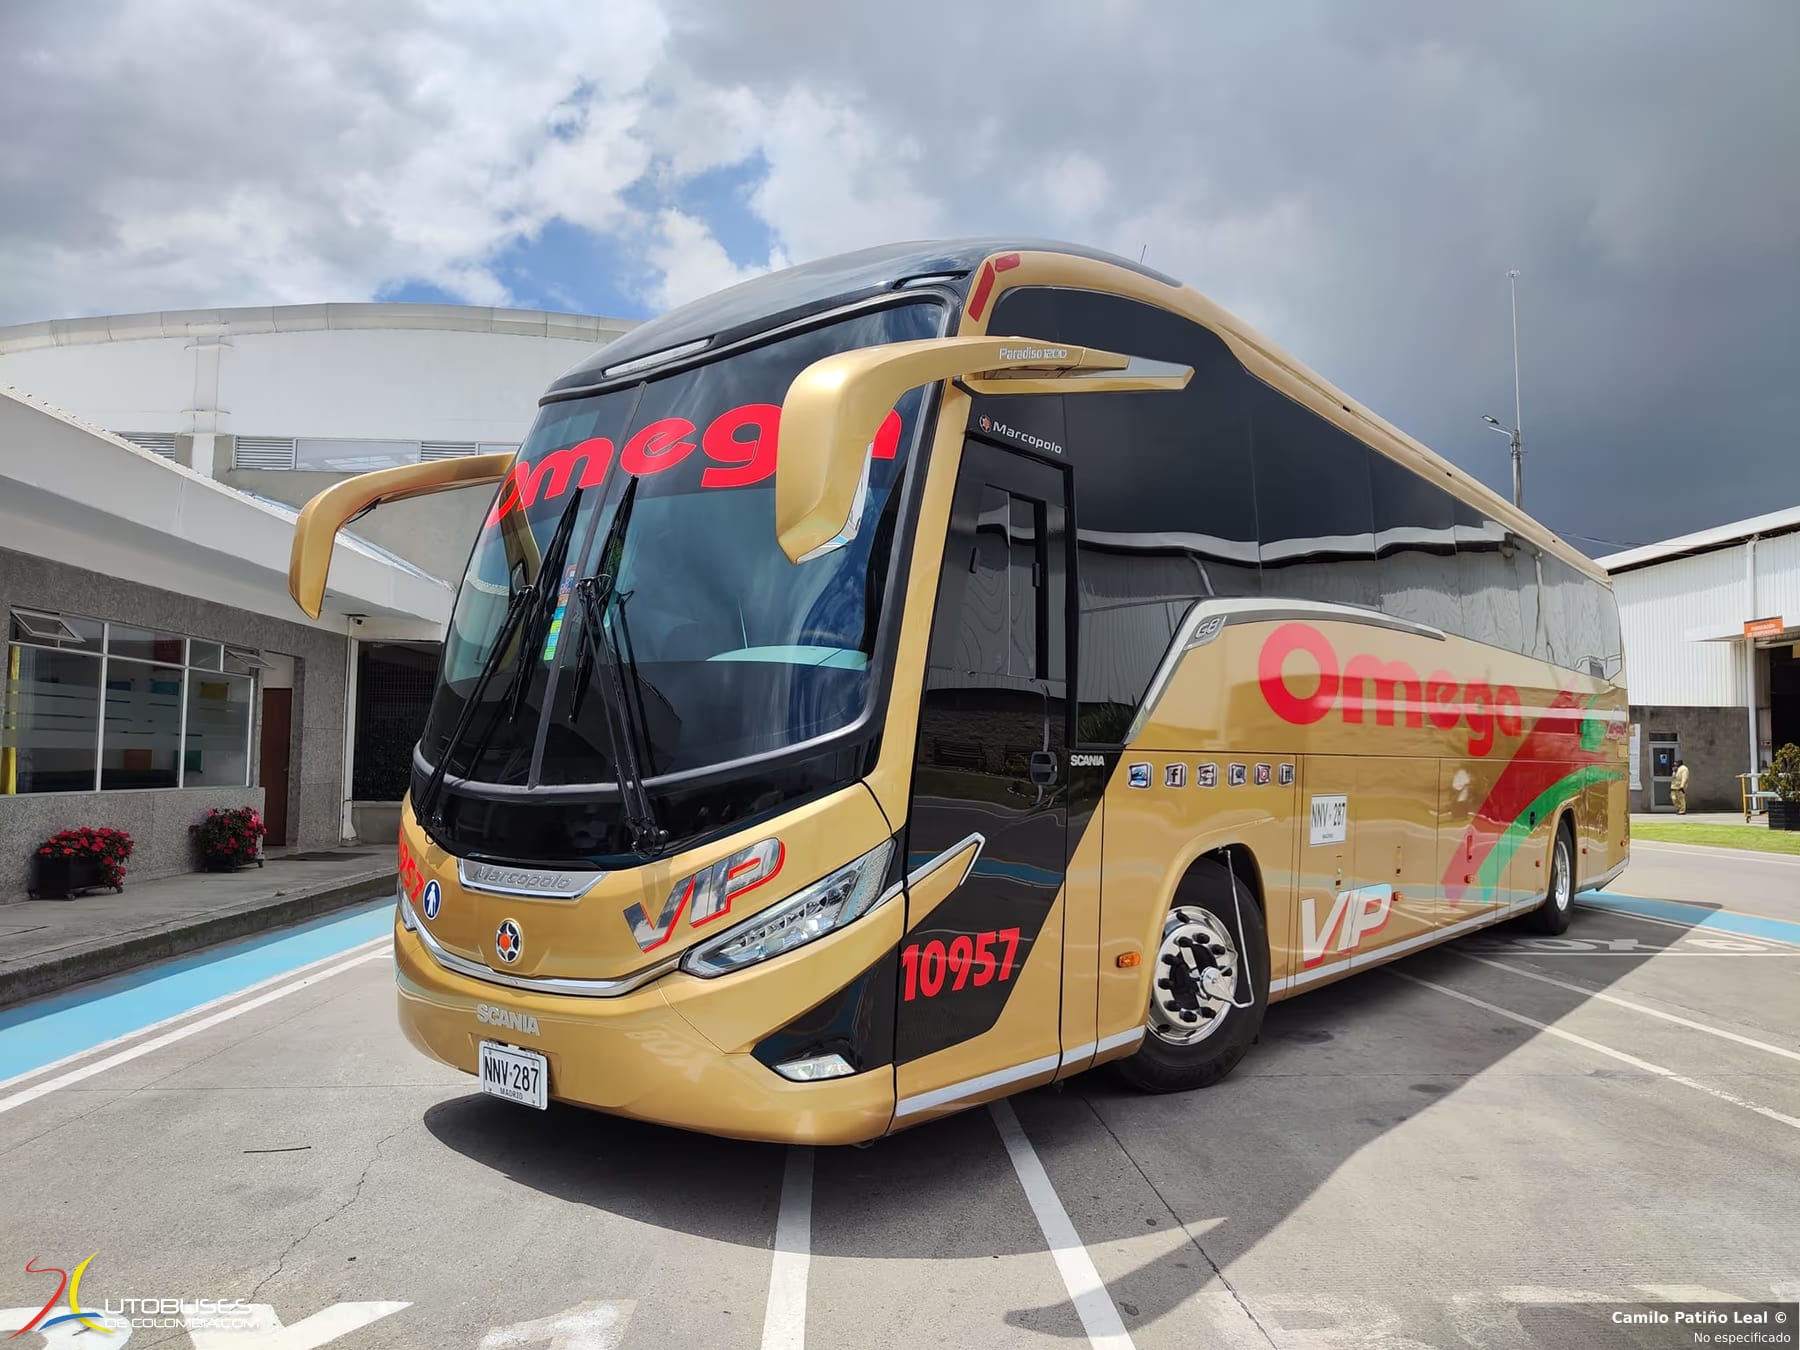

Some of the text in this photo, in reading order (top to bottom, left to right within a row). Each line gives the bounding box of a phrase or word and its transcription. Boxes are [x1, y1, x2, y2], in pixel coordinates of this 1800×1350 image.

[999, 346, 1042, 361] Paradiso
[993, 421, 1063, 455] Marcopolo
[1258, 622, 1522, 757] Omega
[1070, 754, 1105, 767] SCANIA
[472, 865, 572, 889] Marcopolo
[622, 836, 785, 954] VIP
[1301, 883, 1394, 968] VIP
[902, 927, 1019, 1001] 10957
[476, 1004, 541, 1037] SCANIA
[499, 1087, 523, 1100] MADRID
